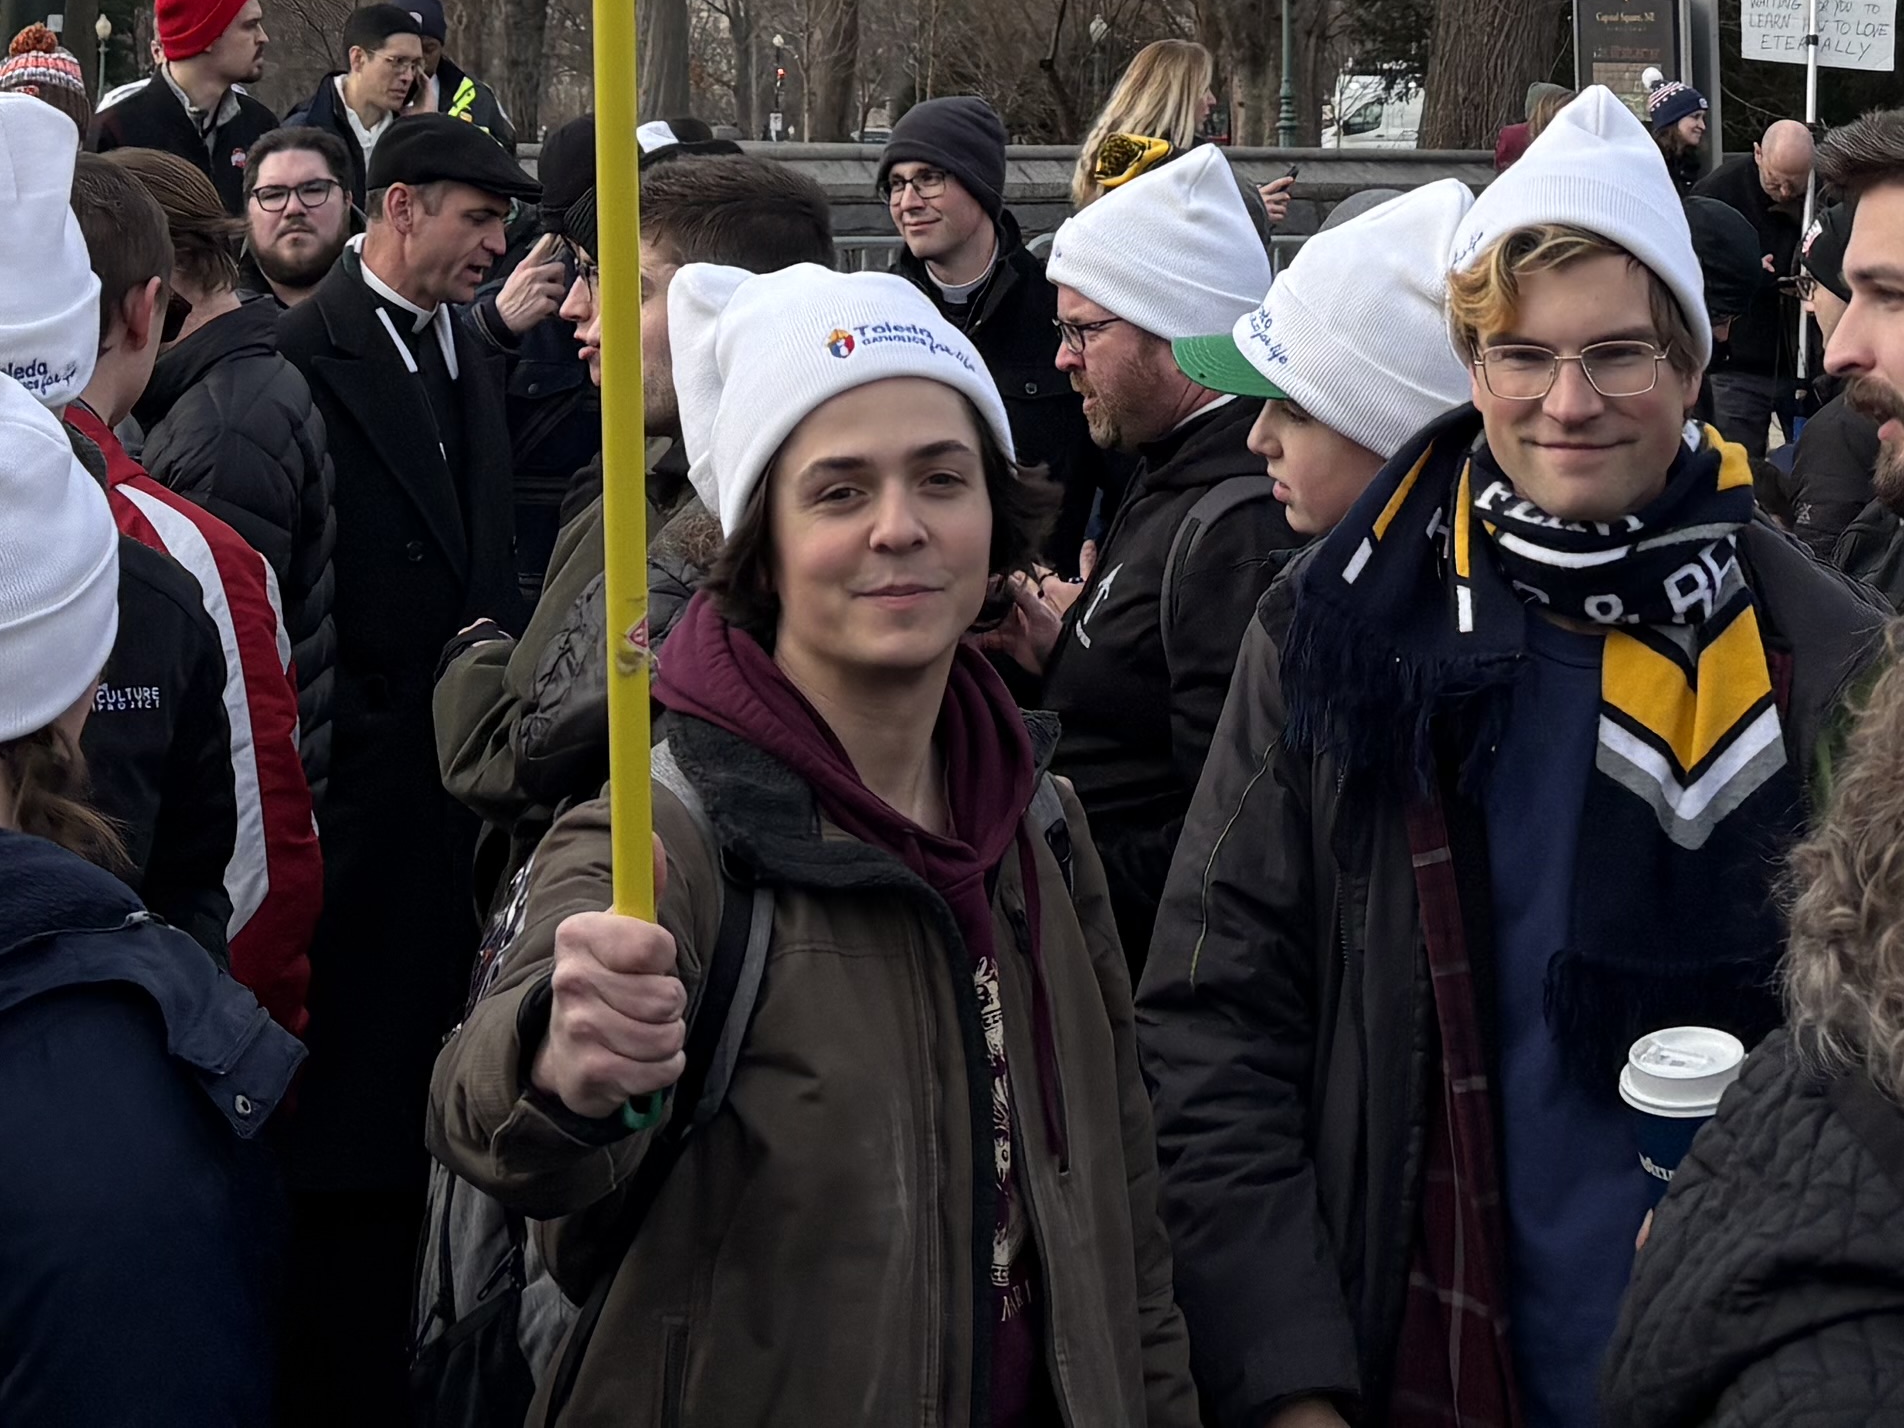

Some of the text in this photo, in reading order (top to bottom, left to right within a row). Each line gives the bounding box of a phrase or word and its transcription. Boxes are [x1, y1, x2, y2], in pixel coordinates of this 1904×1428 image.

[1864, 4, 1880, 15] TO
[1750, 13, 1791, 30] LEARN
[1835, 20, 1851, 35] TO
[96, 686, 160, 703] CULTURE
